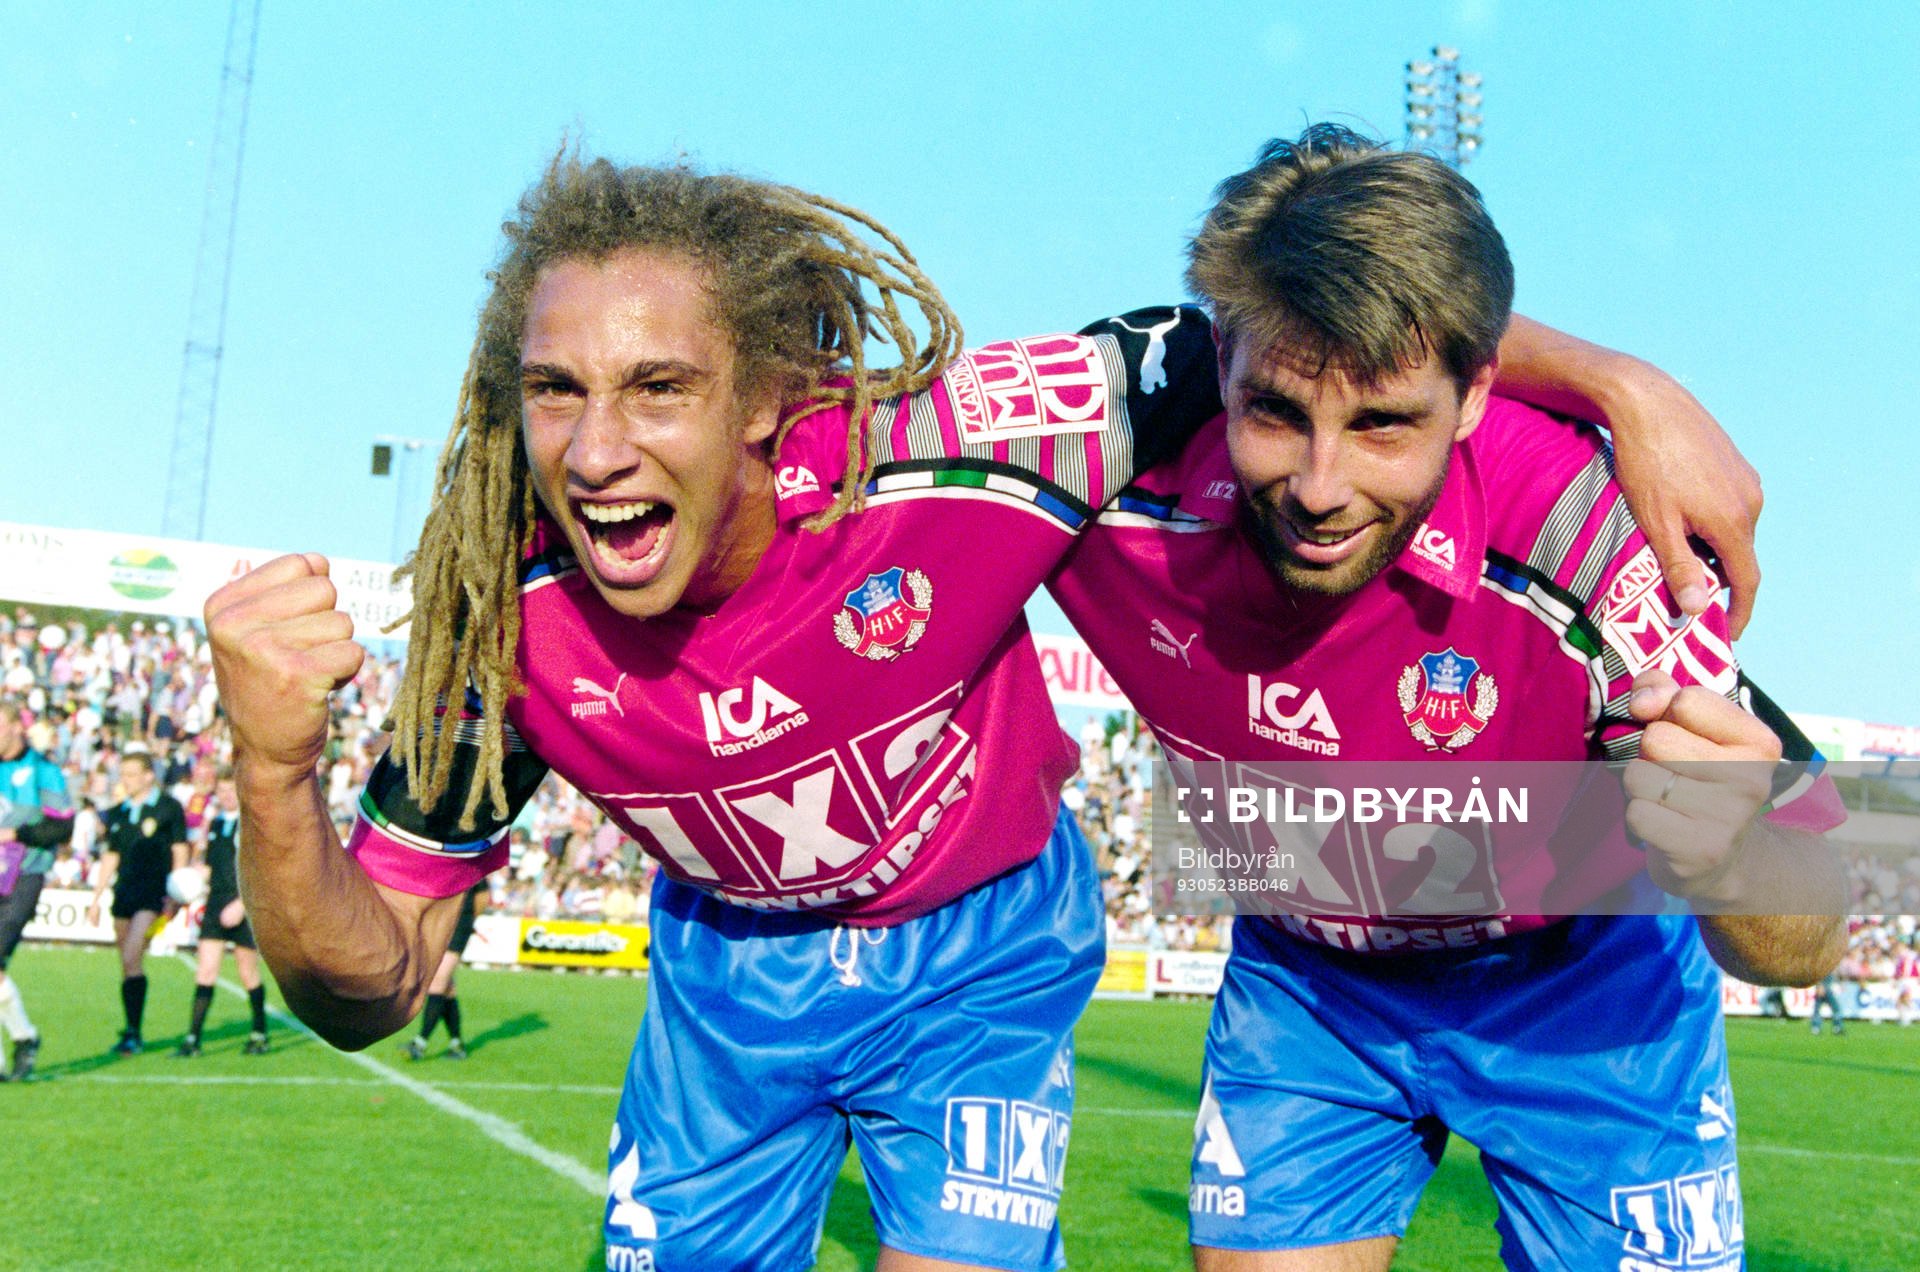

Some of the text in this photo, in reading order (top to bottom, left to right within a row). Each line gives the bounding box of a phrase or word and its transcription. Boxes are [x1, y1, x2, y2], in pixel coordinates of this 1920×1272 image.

[1413, 522, 1456, 564] ICA
[571, 701, 607, 720] PUMA
[699, 675, 802, 742] ICA
[1247, 673, 1341, 739] ICA
[709, 712, 809, 757] handlarna
[1248, 718, 1340, 756] handlarna
